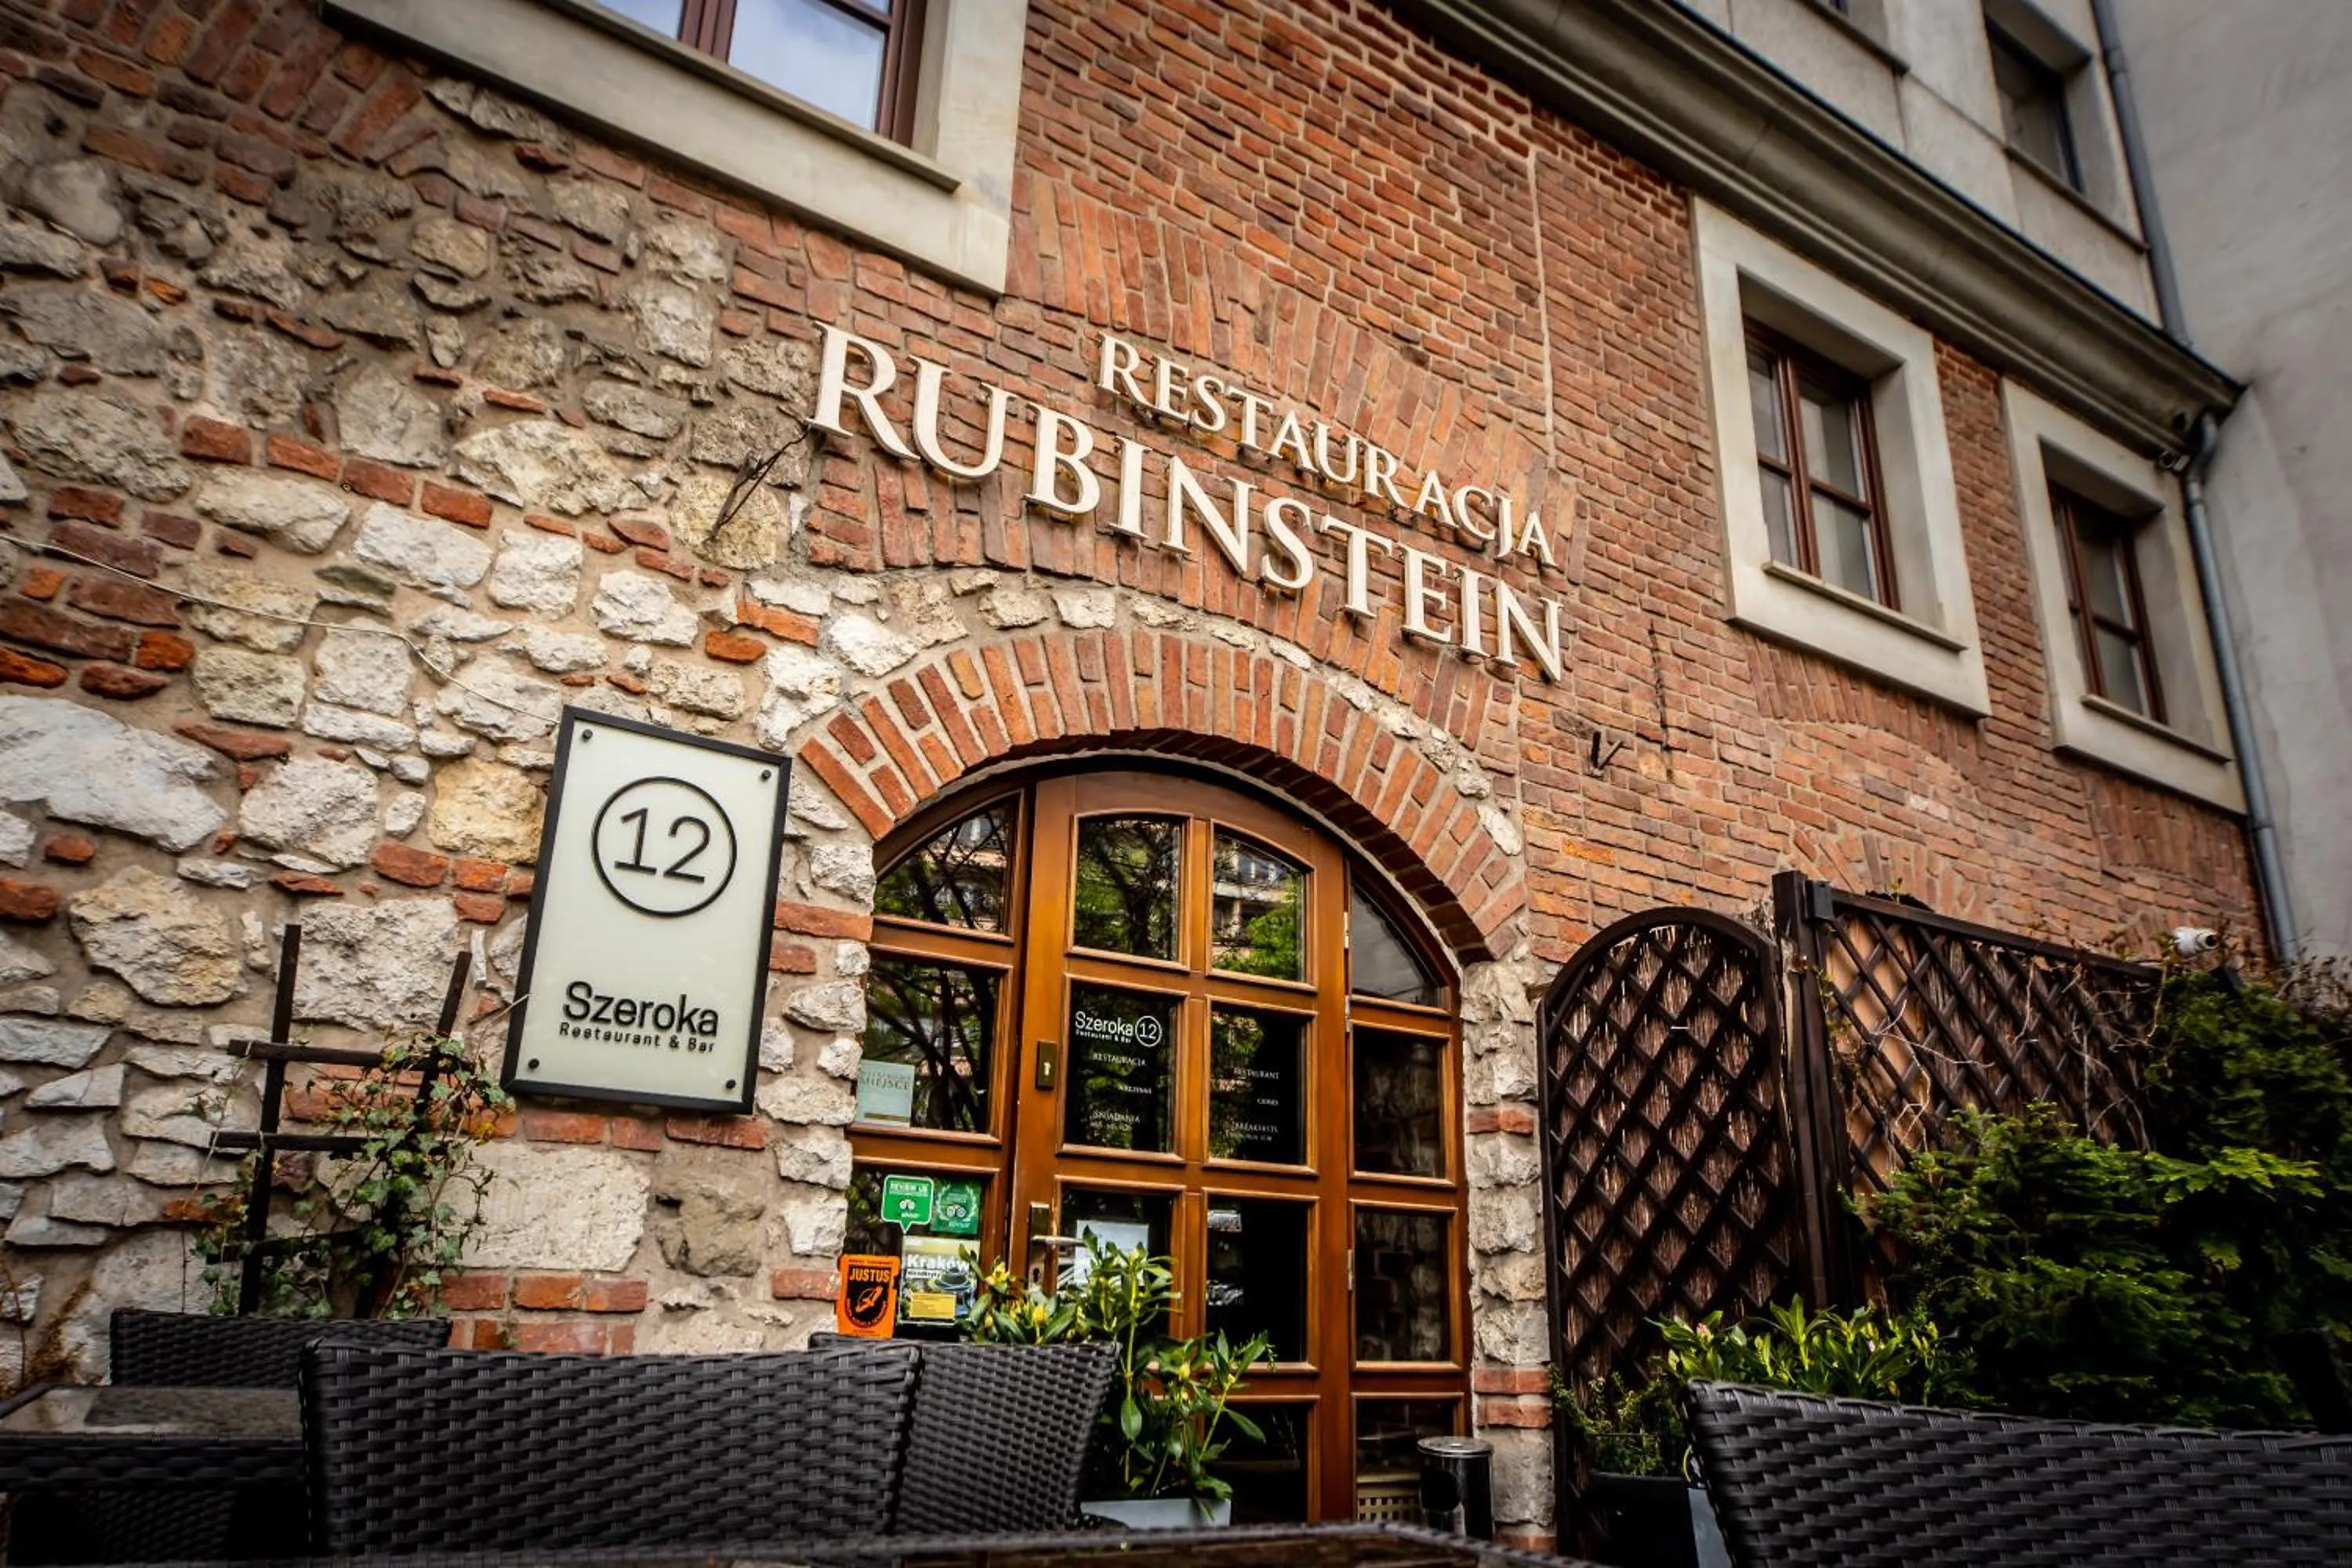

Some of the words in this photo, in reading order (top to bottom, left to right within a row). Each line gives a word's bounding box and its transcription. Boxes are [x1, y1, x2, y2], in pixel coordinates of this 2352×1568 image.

[1098, 331, 1559, 568] RESTAURACJA
[805, 321, 1563, 683] RUBINSTEIN
[614, 807, 711, 884] 12
[563, 981, 719, 1038] Szeroka
[1075, 1011, 1134, 1036] Szeroka
[1139, 1022, 1158, 1040] 12
[559, 1022, 662, 1048] Restaurant
[669, 1035, 680, 1050] &
[688, 1037, 715, 1054] Bar
[849, 1267, 891, 1283] JUSTUS
[907, 1253, 971, 1273] Kraków
